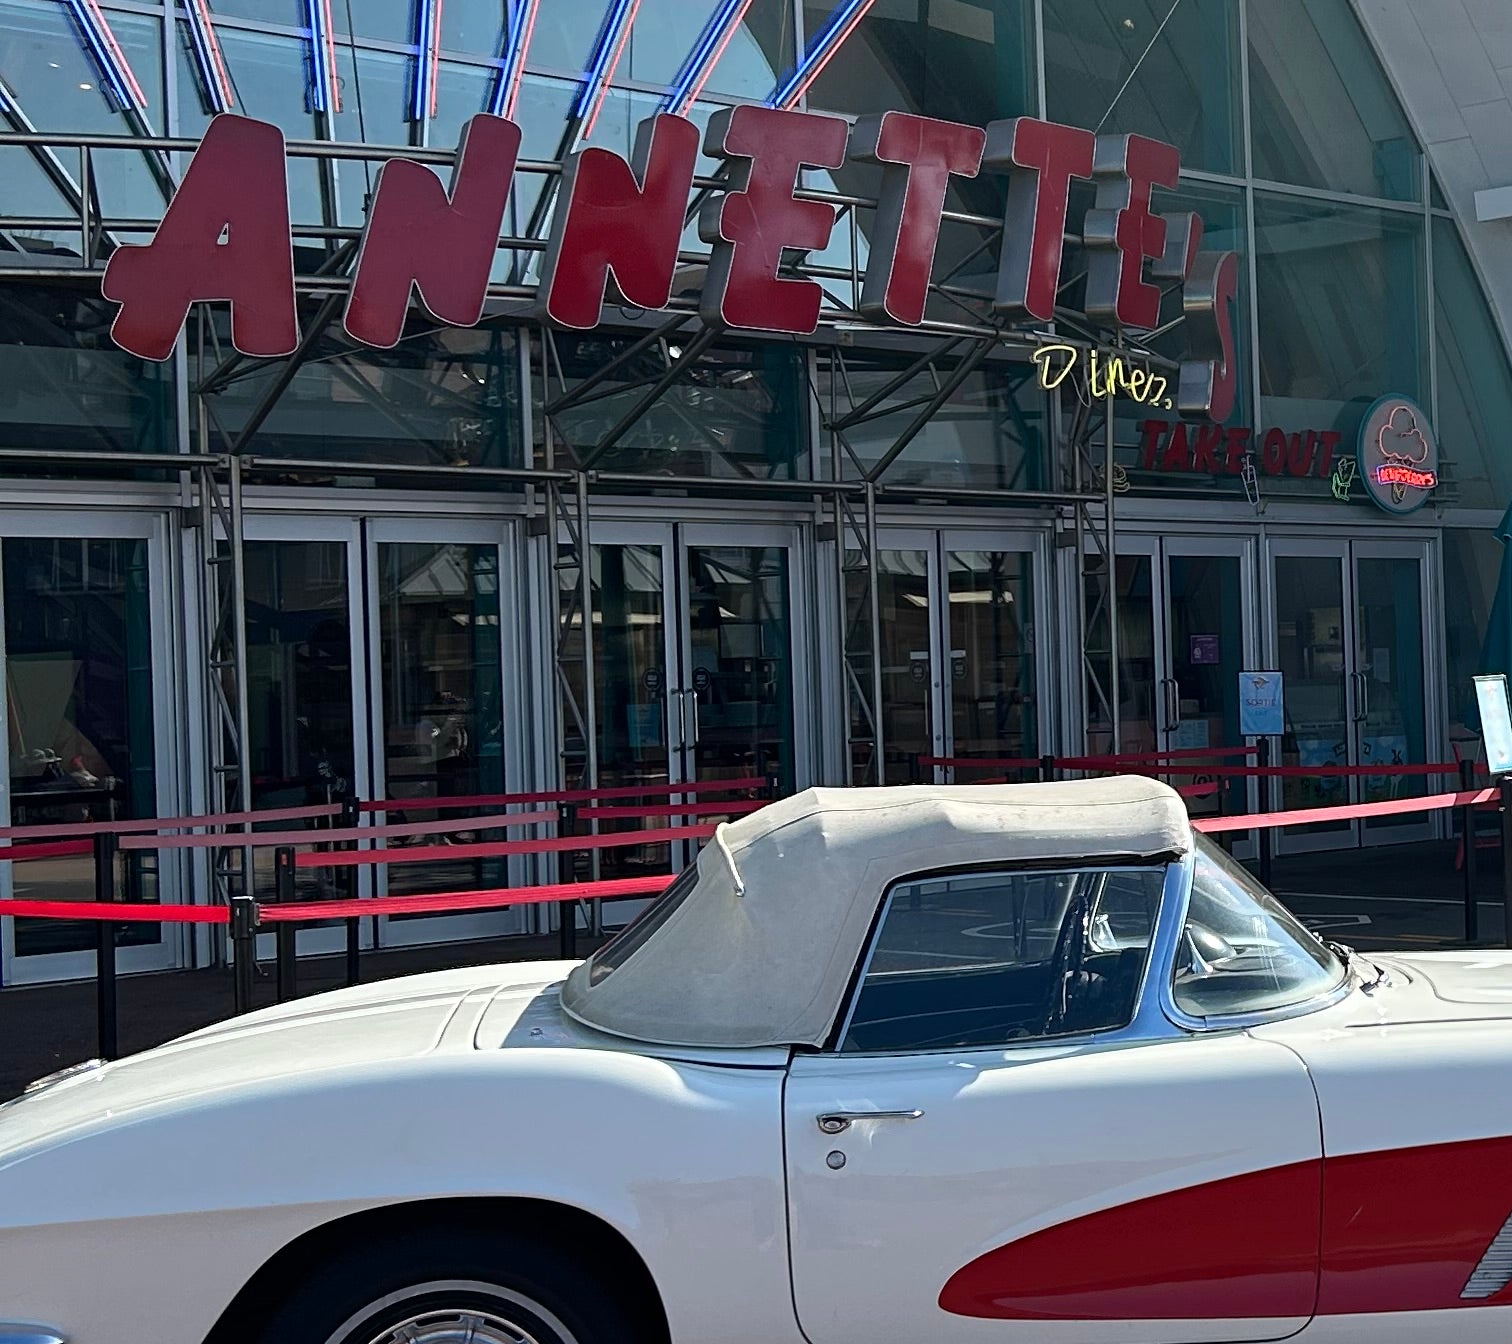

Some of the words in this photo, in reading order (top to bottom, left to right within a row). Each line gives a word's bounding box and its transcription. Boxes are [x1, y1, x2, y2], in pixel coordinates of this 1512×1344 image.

[101, 105, 1238, 423] ANNETTE'S
[1138, 419, 1252, 475] TAKE
[1261, 426, 1341, 478] OUT
